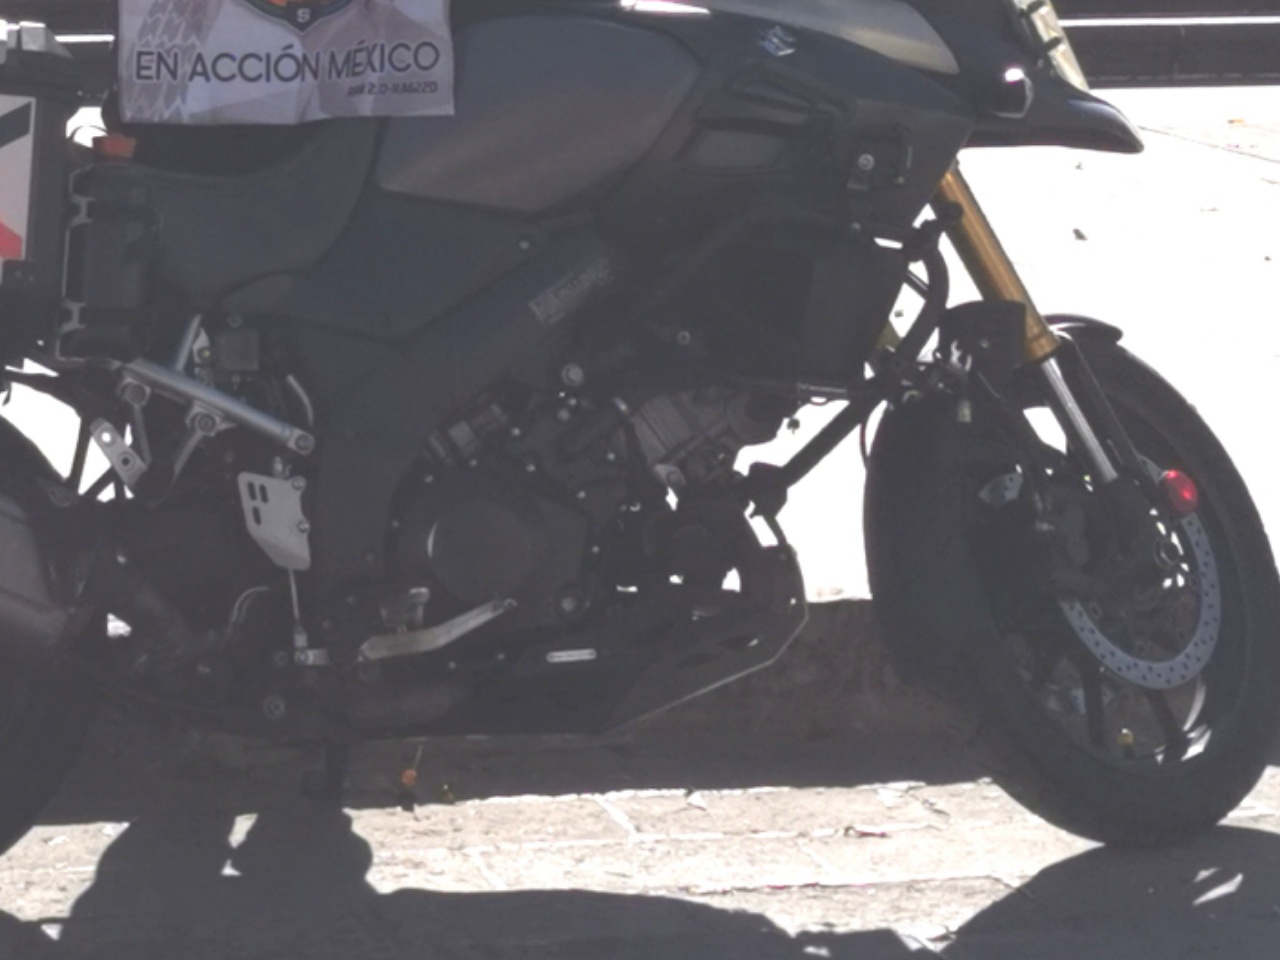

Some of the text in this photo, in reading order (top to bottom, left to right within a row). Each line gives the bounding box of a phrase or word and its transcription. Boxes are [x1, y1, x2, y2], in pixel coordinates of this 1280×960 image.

[296, 8, 311, 23] S
[135, 39, 440, 83] EN ACCIÓN MÉXICO
